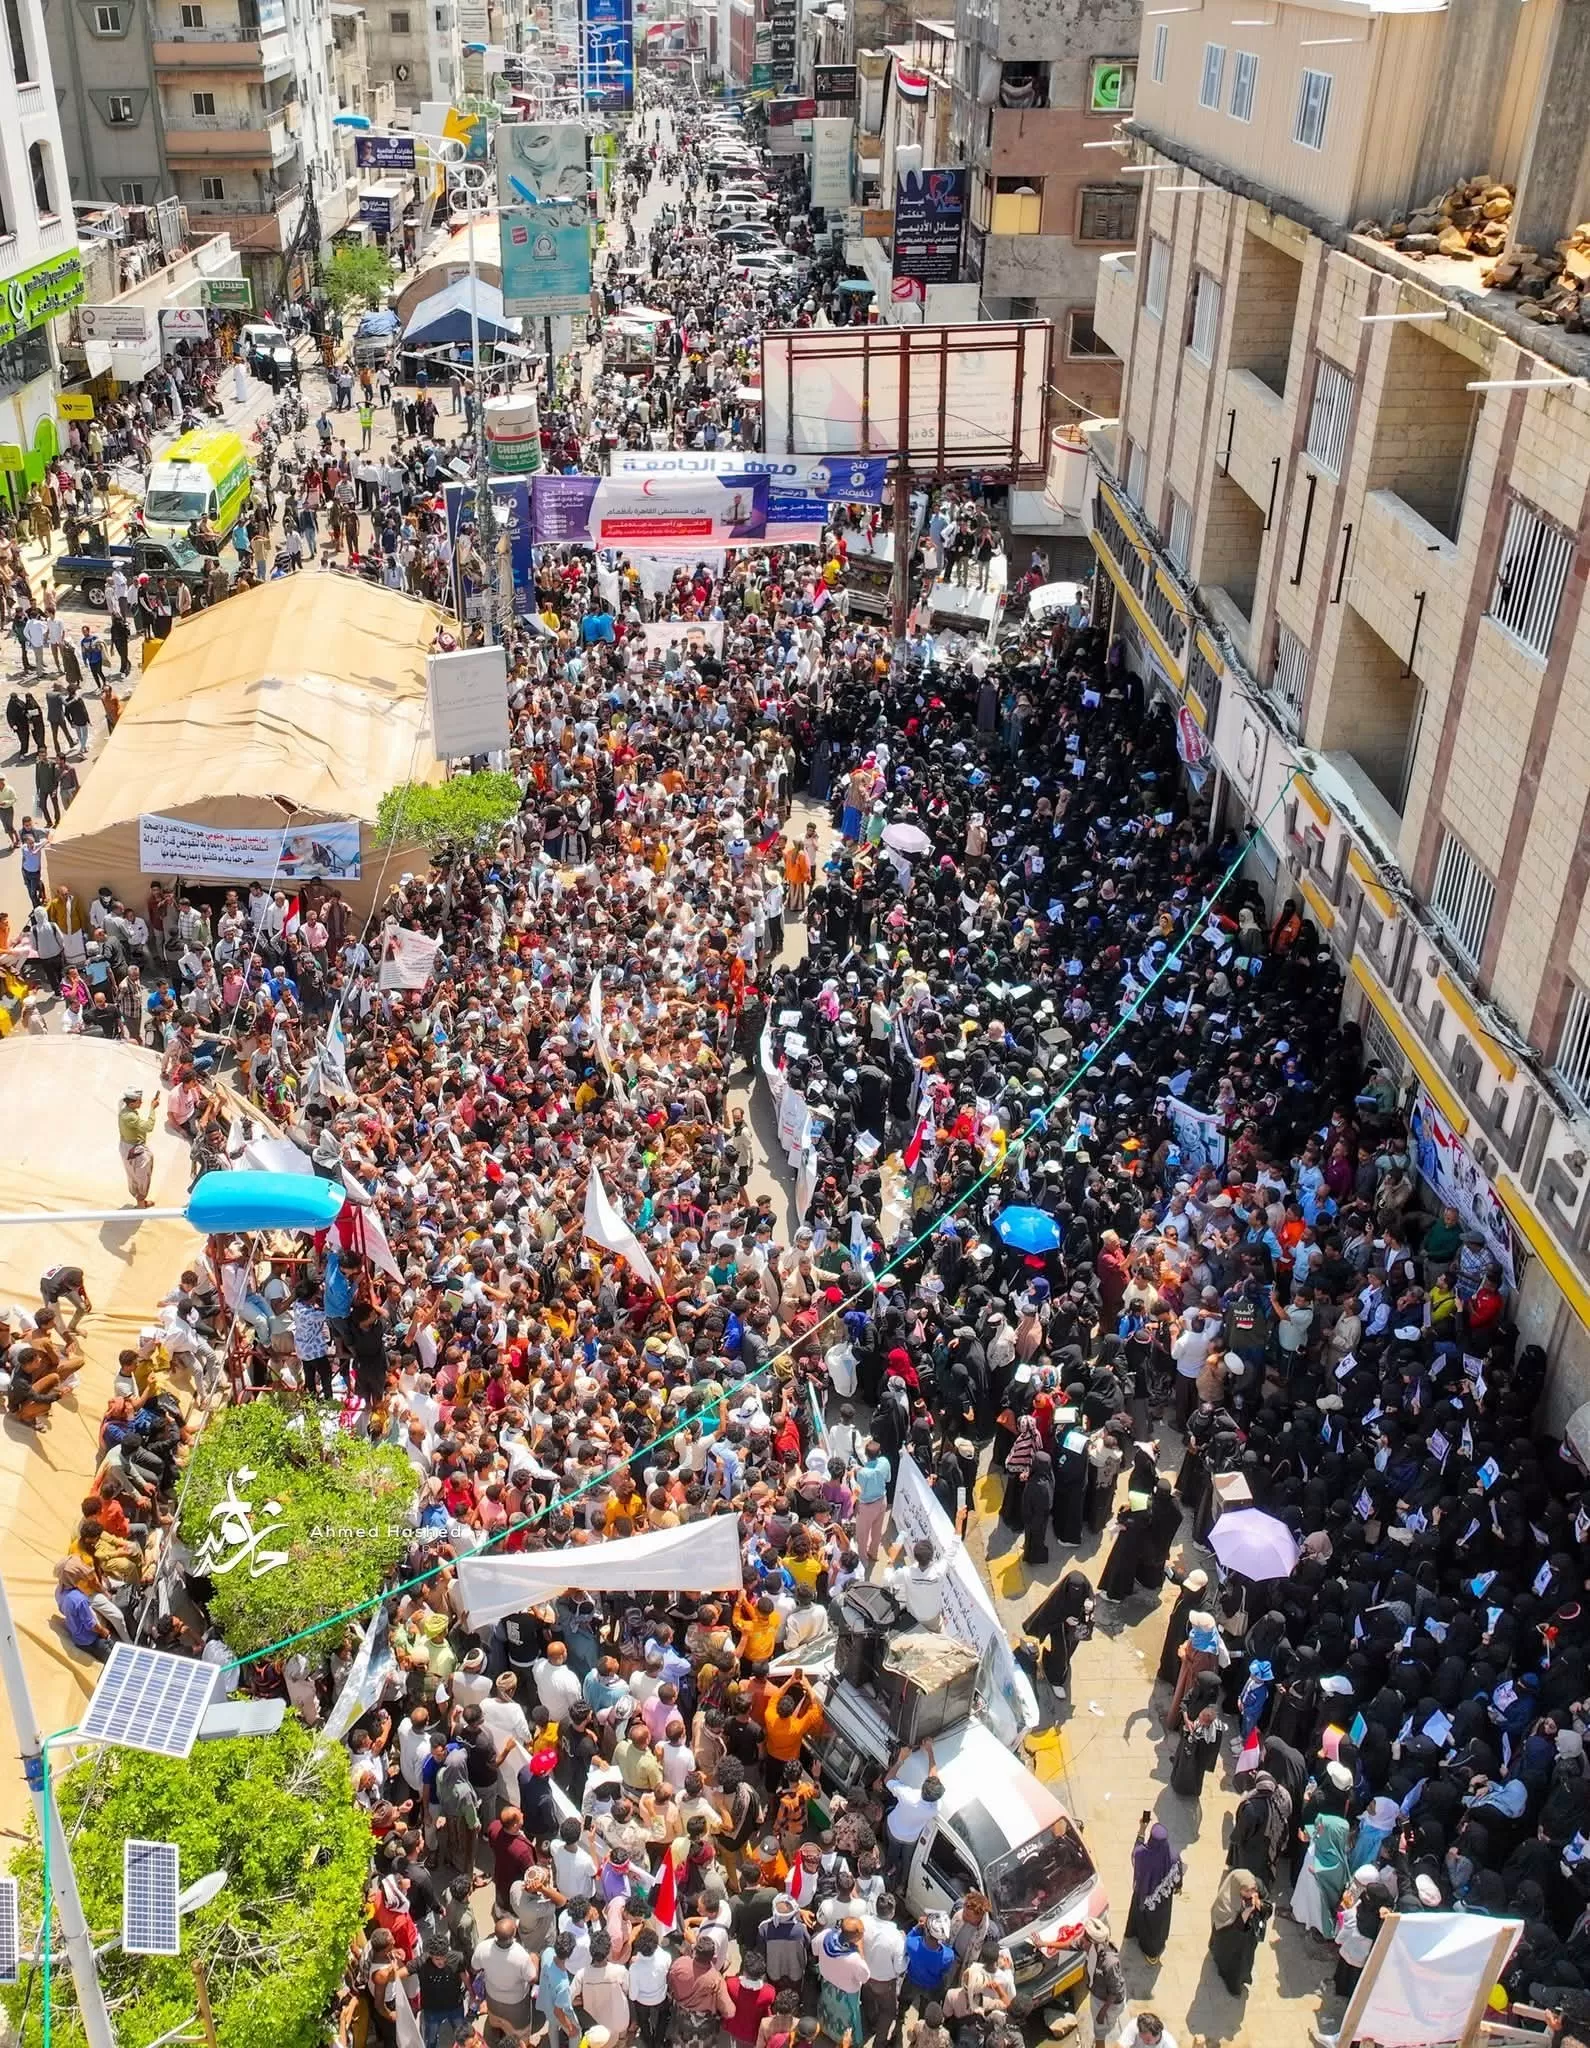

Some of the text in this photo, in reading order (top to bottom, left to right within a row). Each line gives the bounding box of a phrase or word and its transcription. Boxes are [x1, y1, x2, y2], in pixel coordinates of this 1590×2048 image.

[897, 209, 927, 220] الدكتور
[933, 220, 960, 234] عادل
[623, 458, 798, 475] معهد الجامعة
[851, 461, 869, 472] منح
[811, 472, 825, 481] 21
[838, 488, 874, 499] تخفيضات
[1284, 796, 1418, 1003] الدولي
